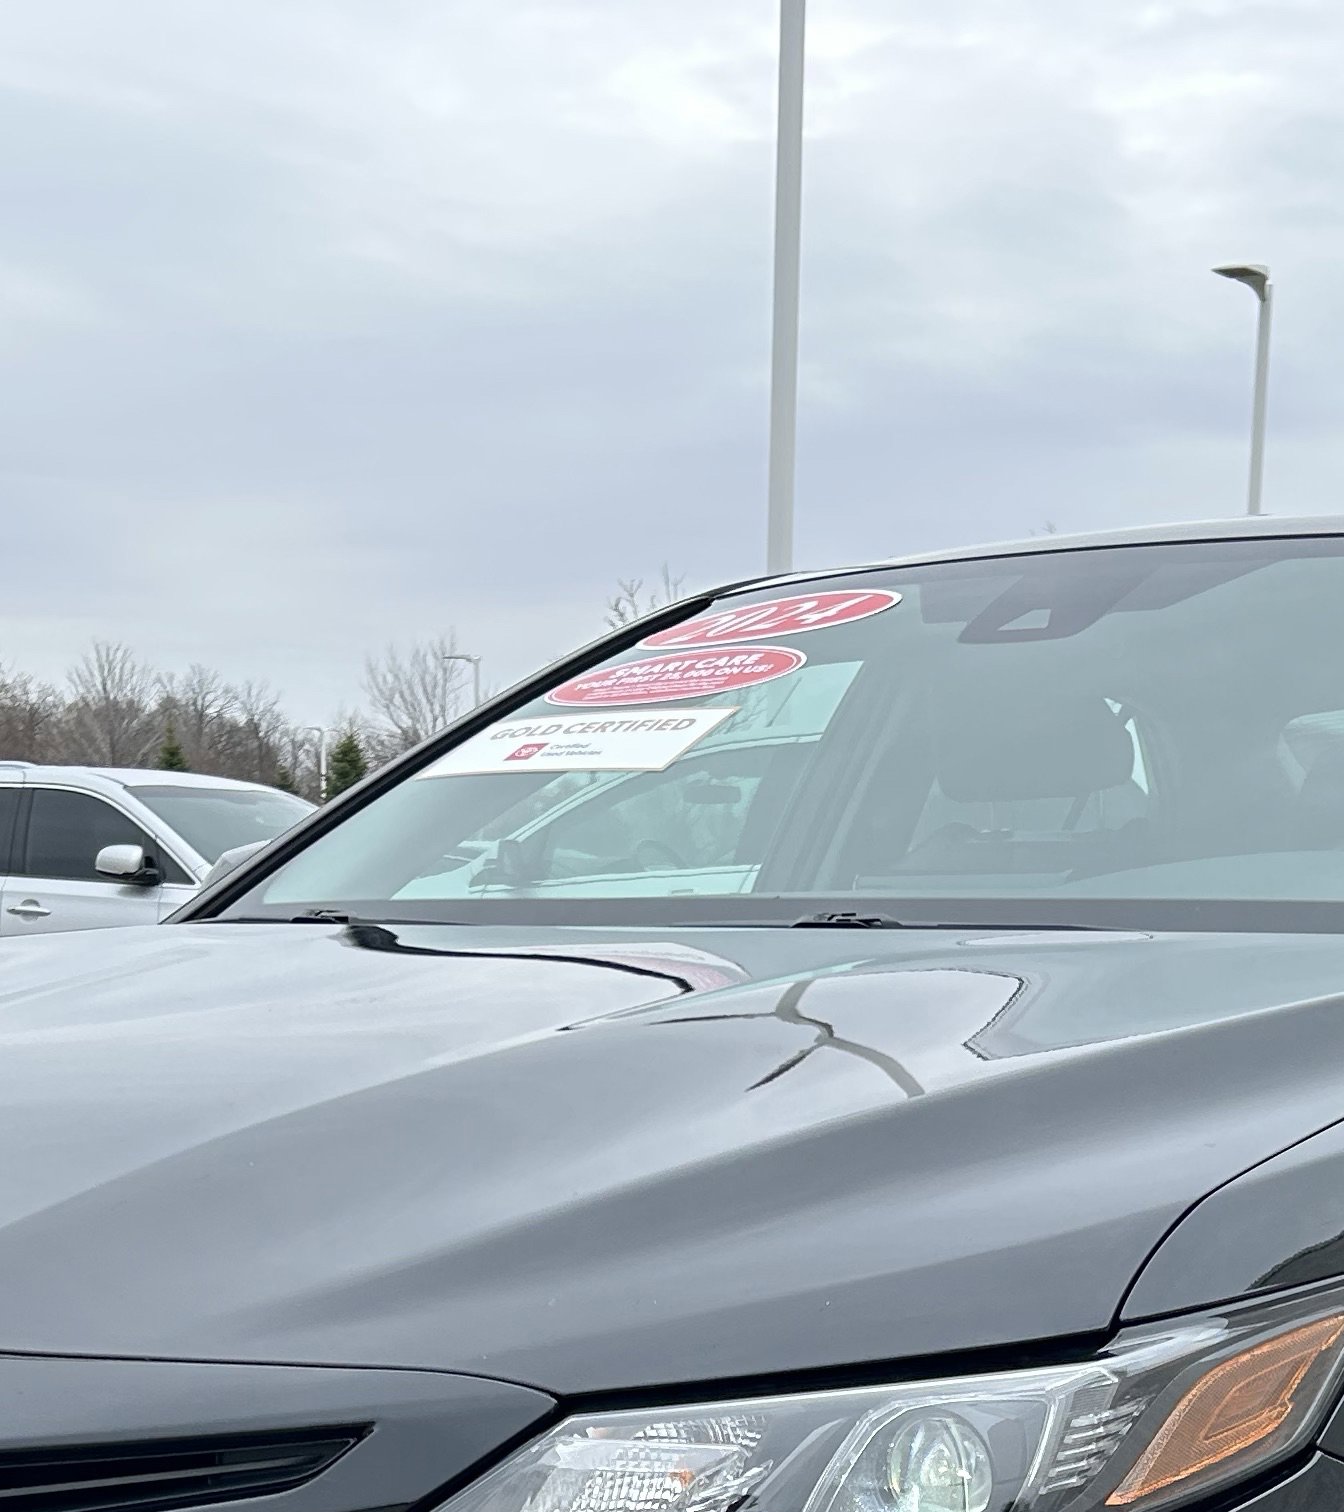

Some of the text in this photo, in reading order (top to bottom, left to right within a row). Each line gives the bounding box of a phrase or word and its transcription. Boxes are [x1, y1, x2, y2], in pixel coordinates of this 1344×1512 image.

[659, 594, 874, 646] 2024
[575, 678, 618, 691] YOUR
[616, 673, 662, 685] FIRST
[714, 665, 749, 675] ON
[609, 653, 765, 679] SMART CARE
[490, 718, 697, 740] GOLD CERTIFIED
